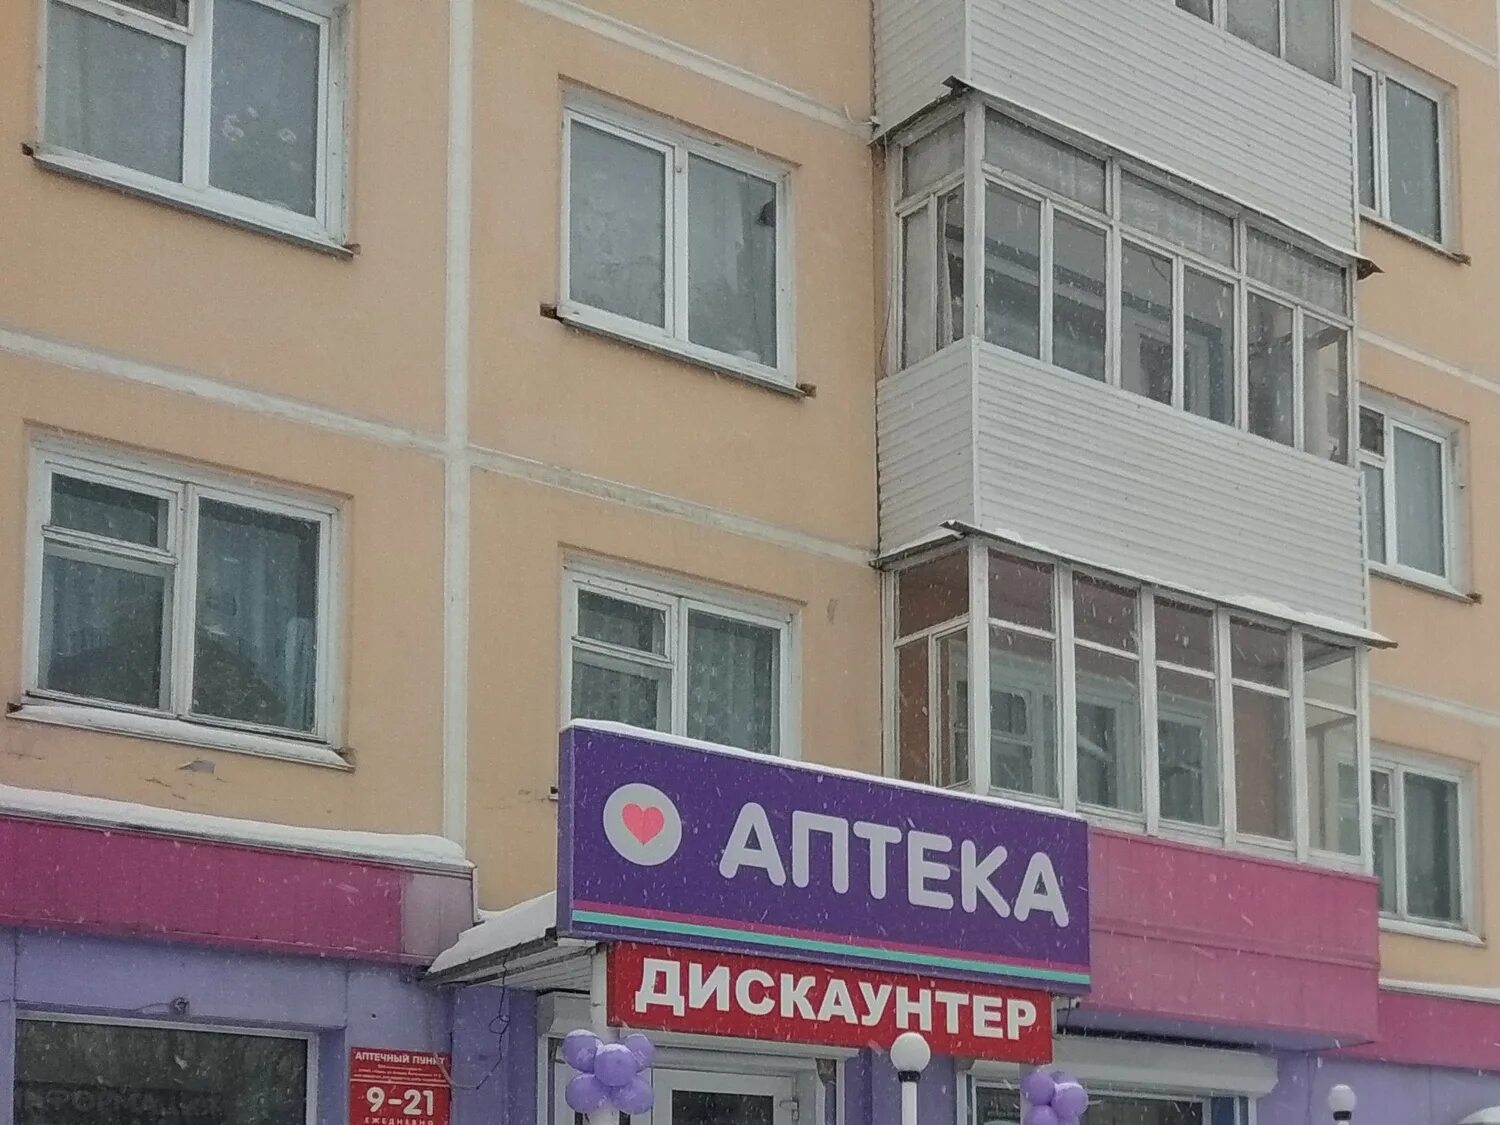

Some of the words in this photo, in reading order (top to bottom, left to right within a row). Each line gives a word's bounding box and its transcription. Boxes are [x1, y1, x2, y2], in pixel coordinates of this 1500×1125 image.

[718, 802, 1070, 928] АПТЕКА
[634, 957, 1038, 1041] ДИСКАУНТЕР
[354, 1051, 410, 1065] АПТЕЧНЫЙ
[366, 1086, 434, 1116] 9-21
